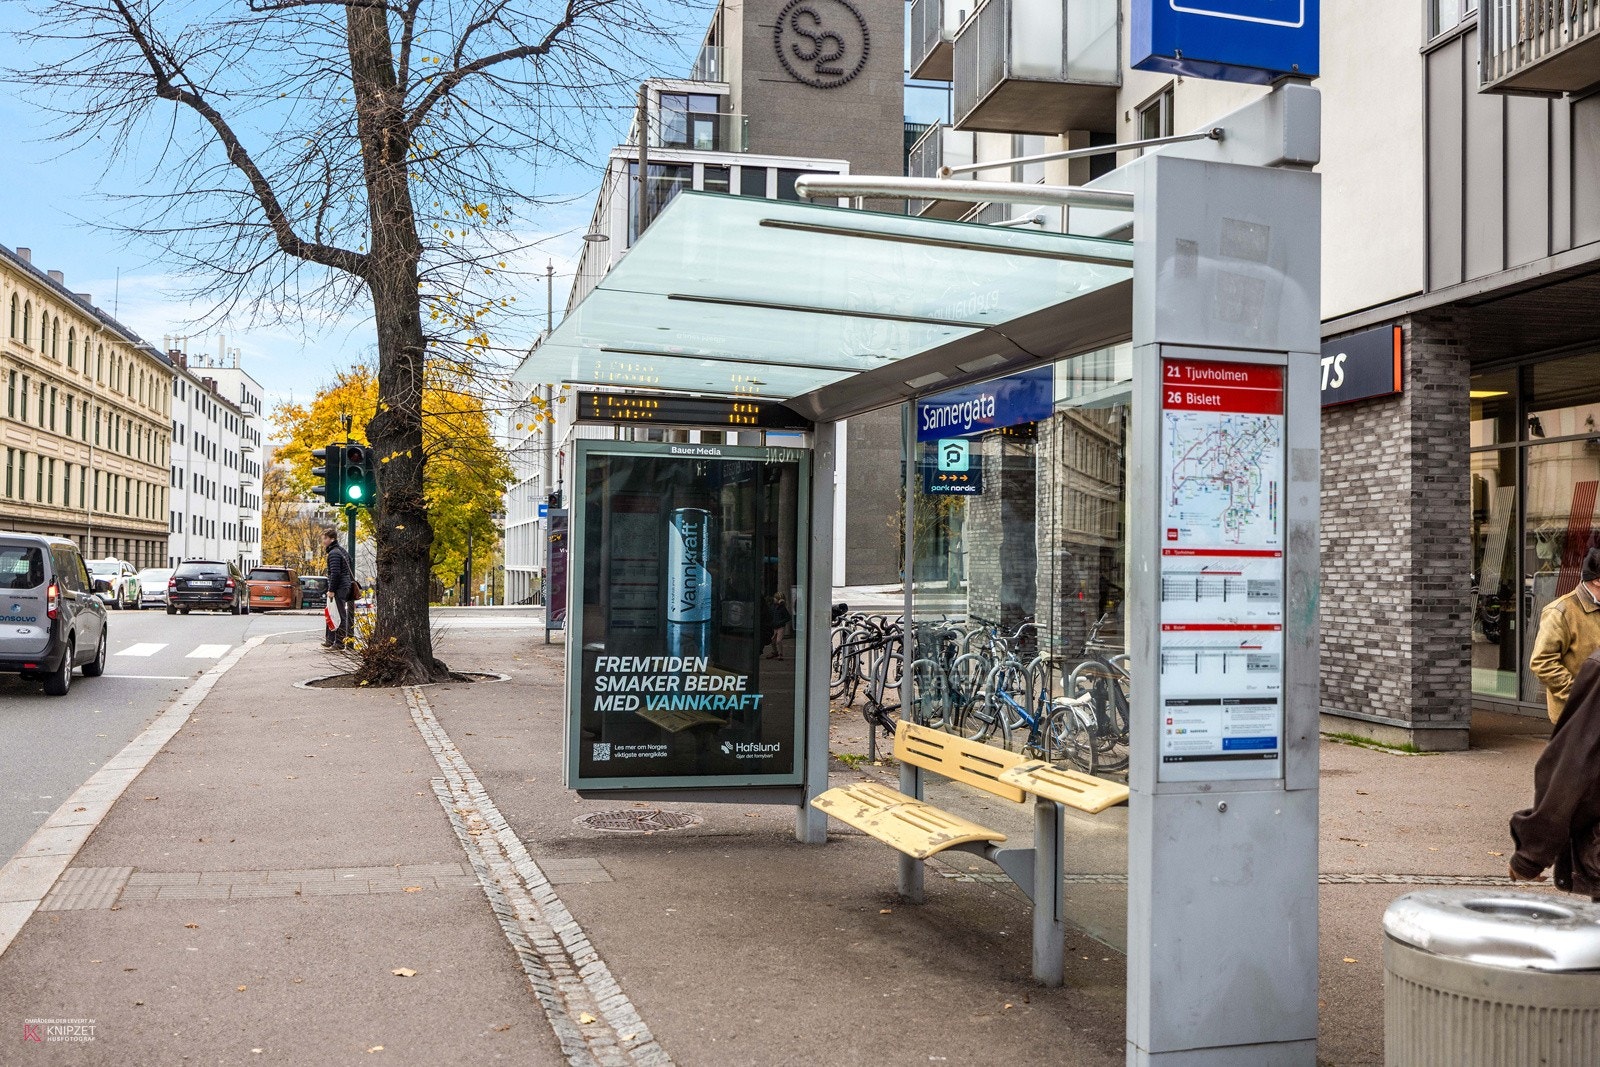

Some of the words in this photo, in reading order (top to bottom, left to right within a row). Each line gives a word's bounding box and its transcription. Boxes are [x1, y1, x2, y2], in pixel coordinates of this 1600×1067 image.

[1167, 366, 1181, 378] 21
[1185, 366, 1248, 381] Tjuvholmen
[1167, 392, 1182, 404] 26
[1186, 392, 1221, 406] Bislett
[923, 393, 995, 431] Sannergata
[671, 446, 696, 454] Bauer
[696, 448, 721, 456] Media
[931, 484, 950, 492] park
[680, 522, 698, 613] Vannkraft
[594, 656, 708, 673] FREMTIDEN
[594, 676, 680, 692] SMAKER
[684, 676, 748, 692] BEDRE
[594, 695, 640, 712] MED
[645, 694, 764, 710] VANNKRAFT
[736, 742, 780, 752] Hafslund
